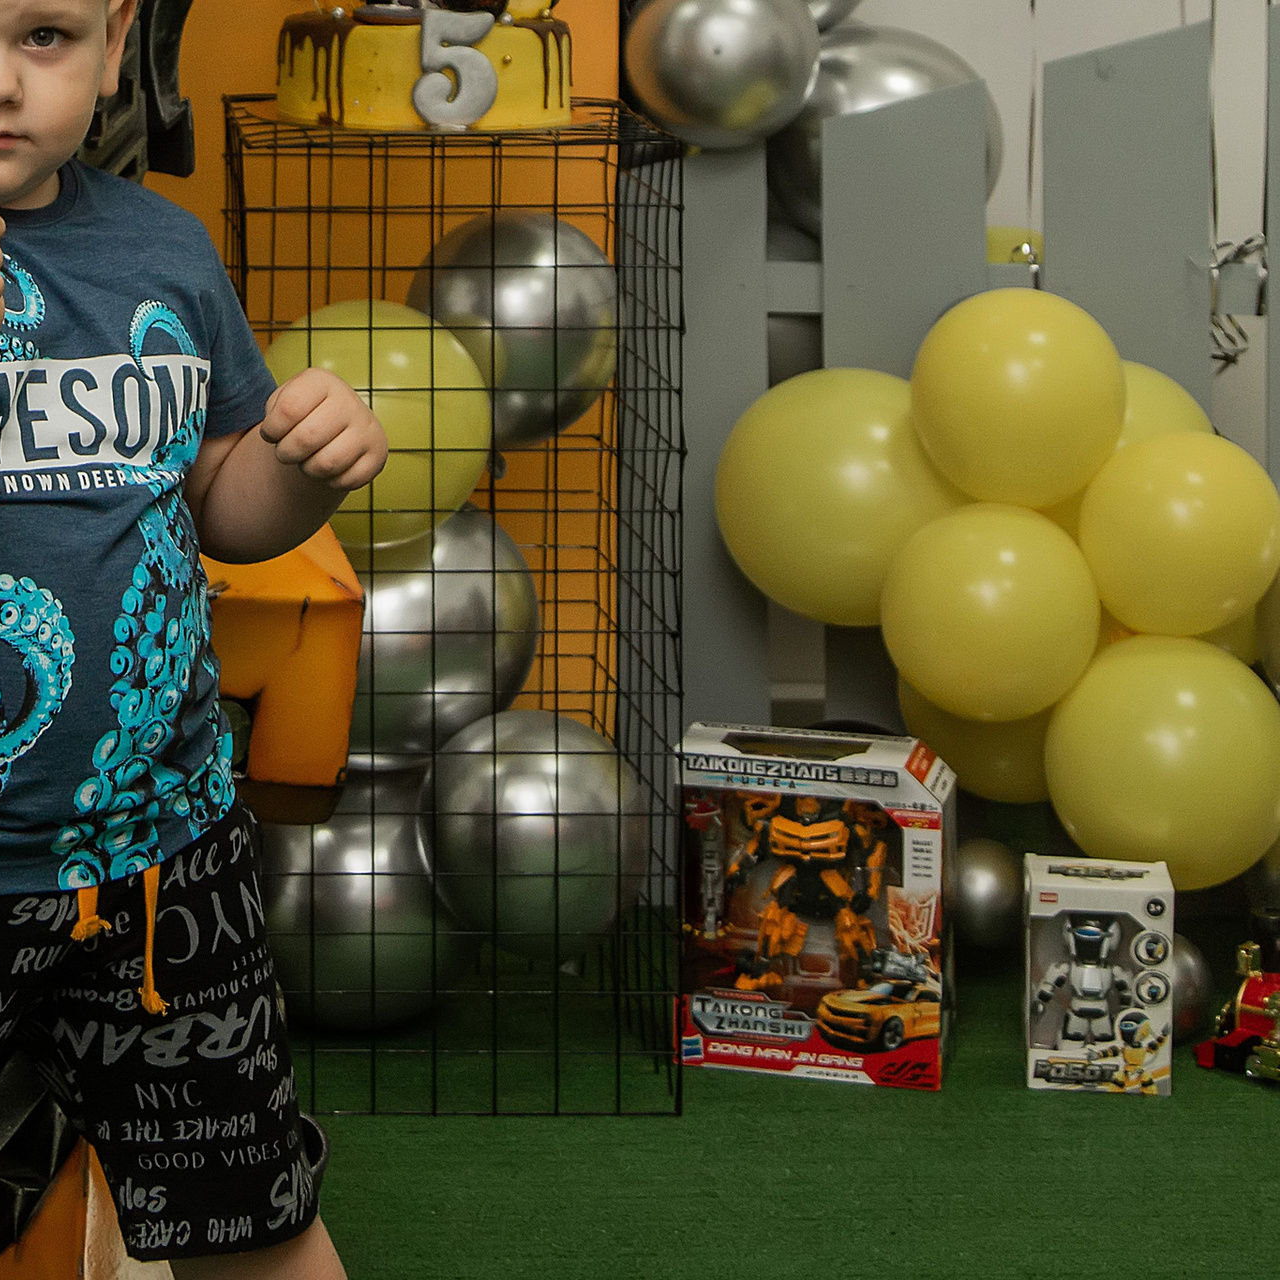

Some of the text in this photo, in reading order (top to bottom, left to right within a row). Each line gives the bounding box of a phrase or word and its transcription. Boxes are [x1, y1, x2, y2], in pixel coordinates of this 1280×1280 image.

[412, 8, 498, 131] 5
[78, 468, 127, 490] DEEP
[173, 974, 249, 1012] FAMOUS
[237, 1043, 278, 1081] Style
[134, 1079, 203, 1110] NYC
[120, 1119, 165, 1143] THE
[172, 1111, 256, 1143] BRAKE
[138, 1140, 281, 1170] GOOD VIBES
[207, 1215, 254, 1244] WHO
